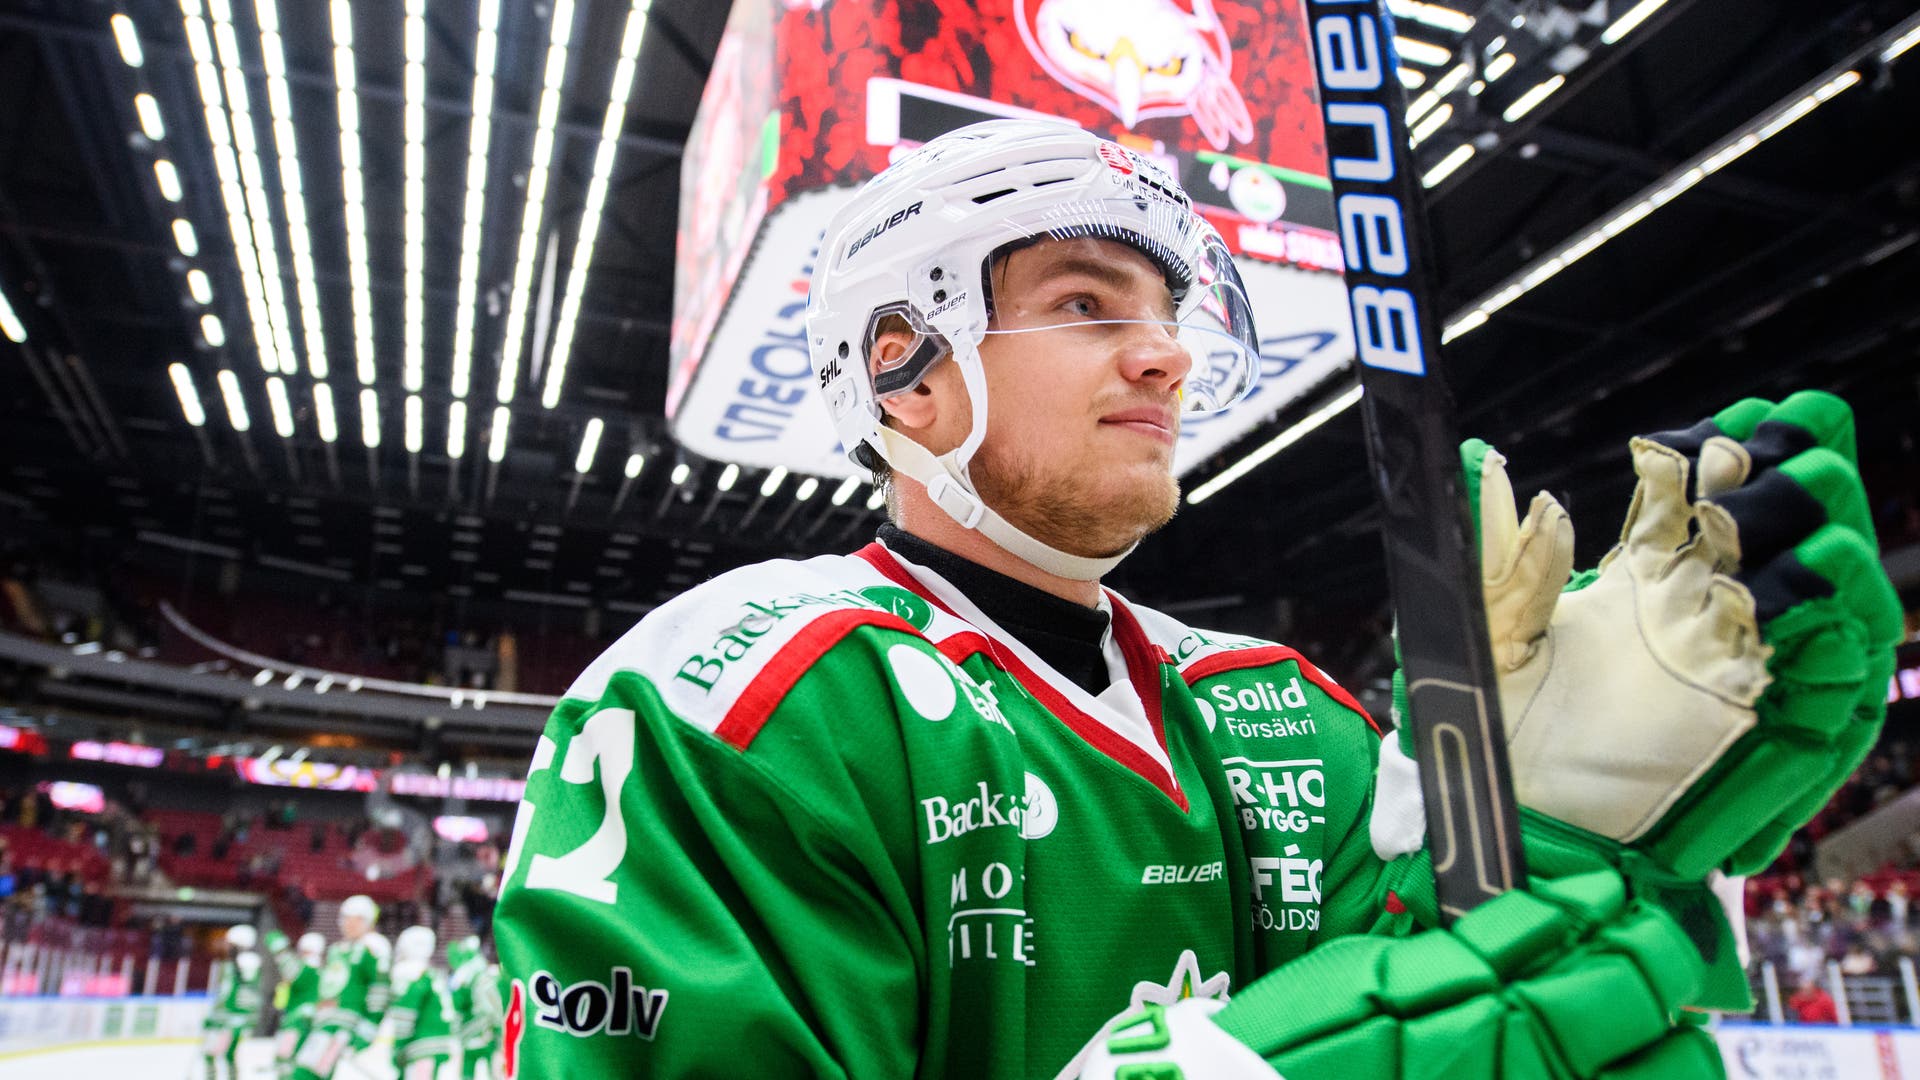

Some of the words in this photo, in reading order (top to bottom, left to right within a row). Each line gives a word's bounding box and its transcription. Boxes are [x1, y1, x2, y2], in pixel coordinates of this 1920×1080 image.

[1309, 0, 1427, 376] BAUE
[820, 358, 842, 390] SHL
[1210, 677, 1308, 713] Solid
[530, 967, 669, 1041] golv
